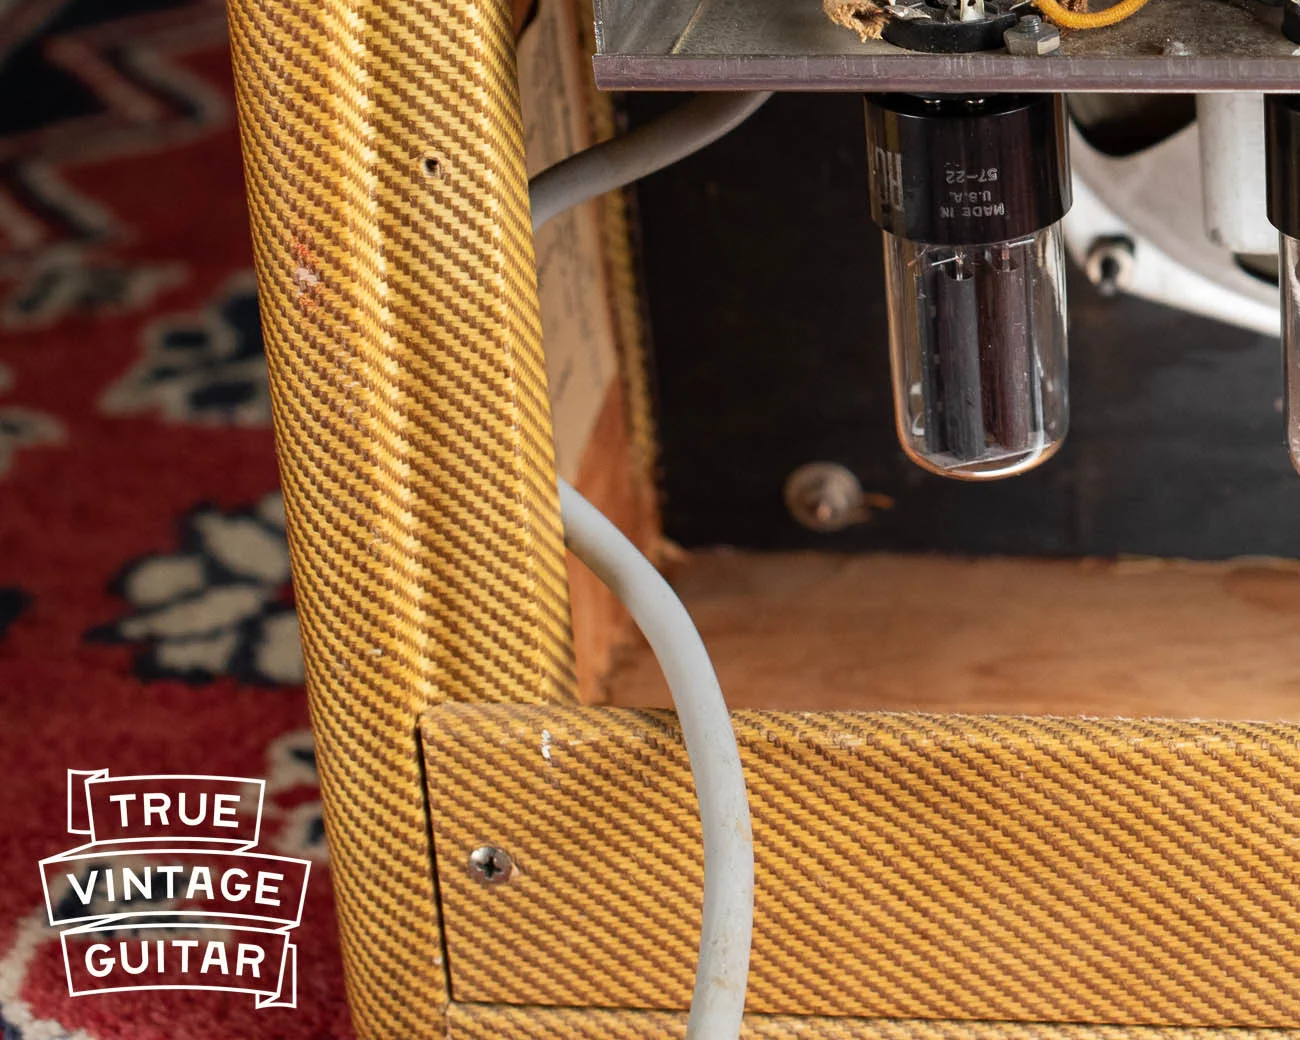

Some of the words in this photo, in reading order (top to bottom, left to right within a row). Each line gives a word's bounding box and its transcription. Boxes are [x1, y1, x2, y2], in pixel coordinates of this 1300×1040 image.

[949, 191, 991, 203] U.S.A.
[940, 206, 954, 218] IN
[963, 202, 1005, 217] MADE
